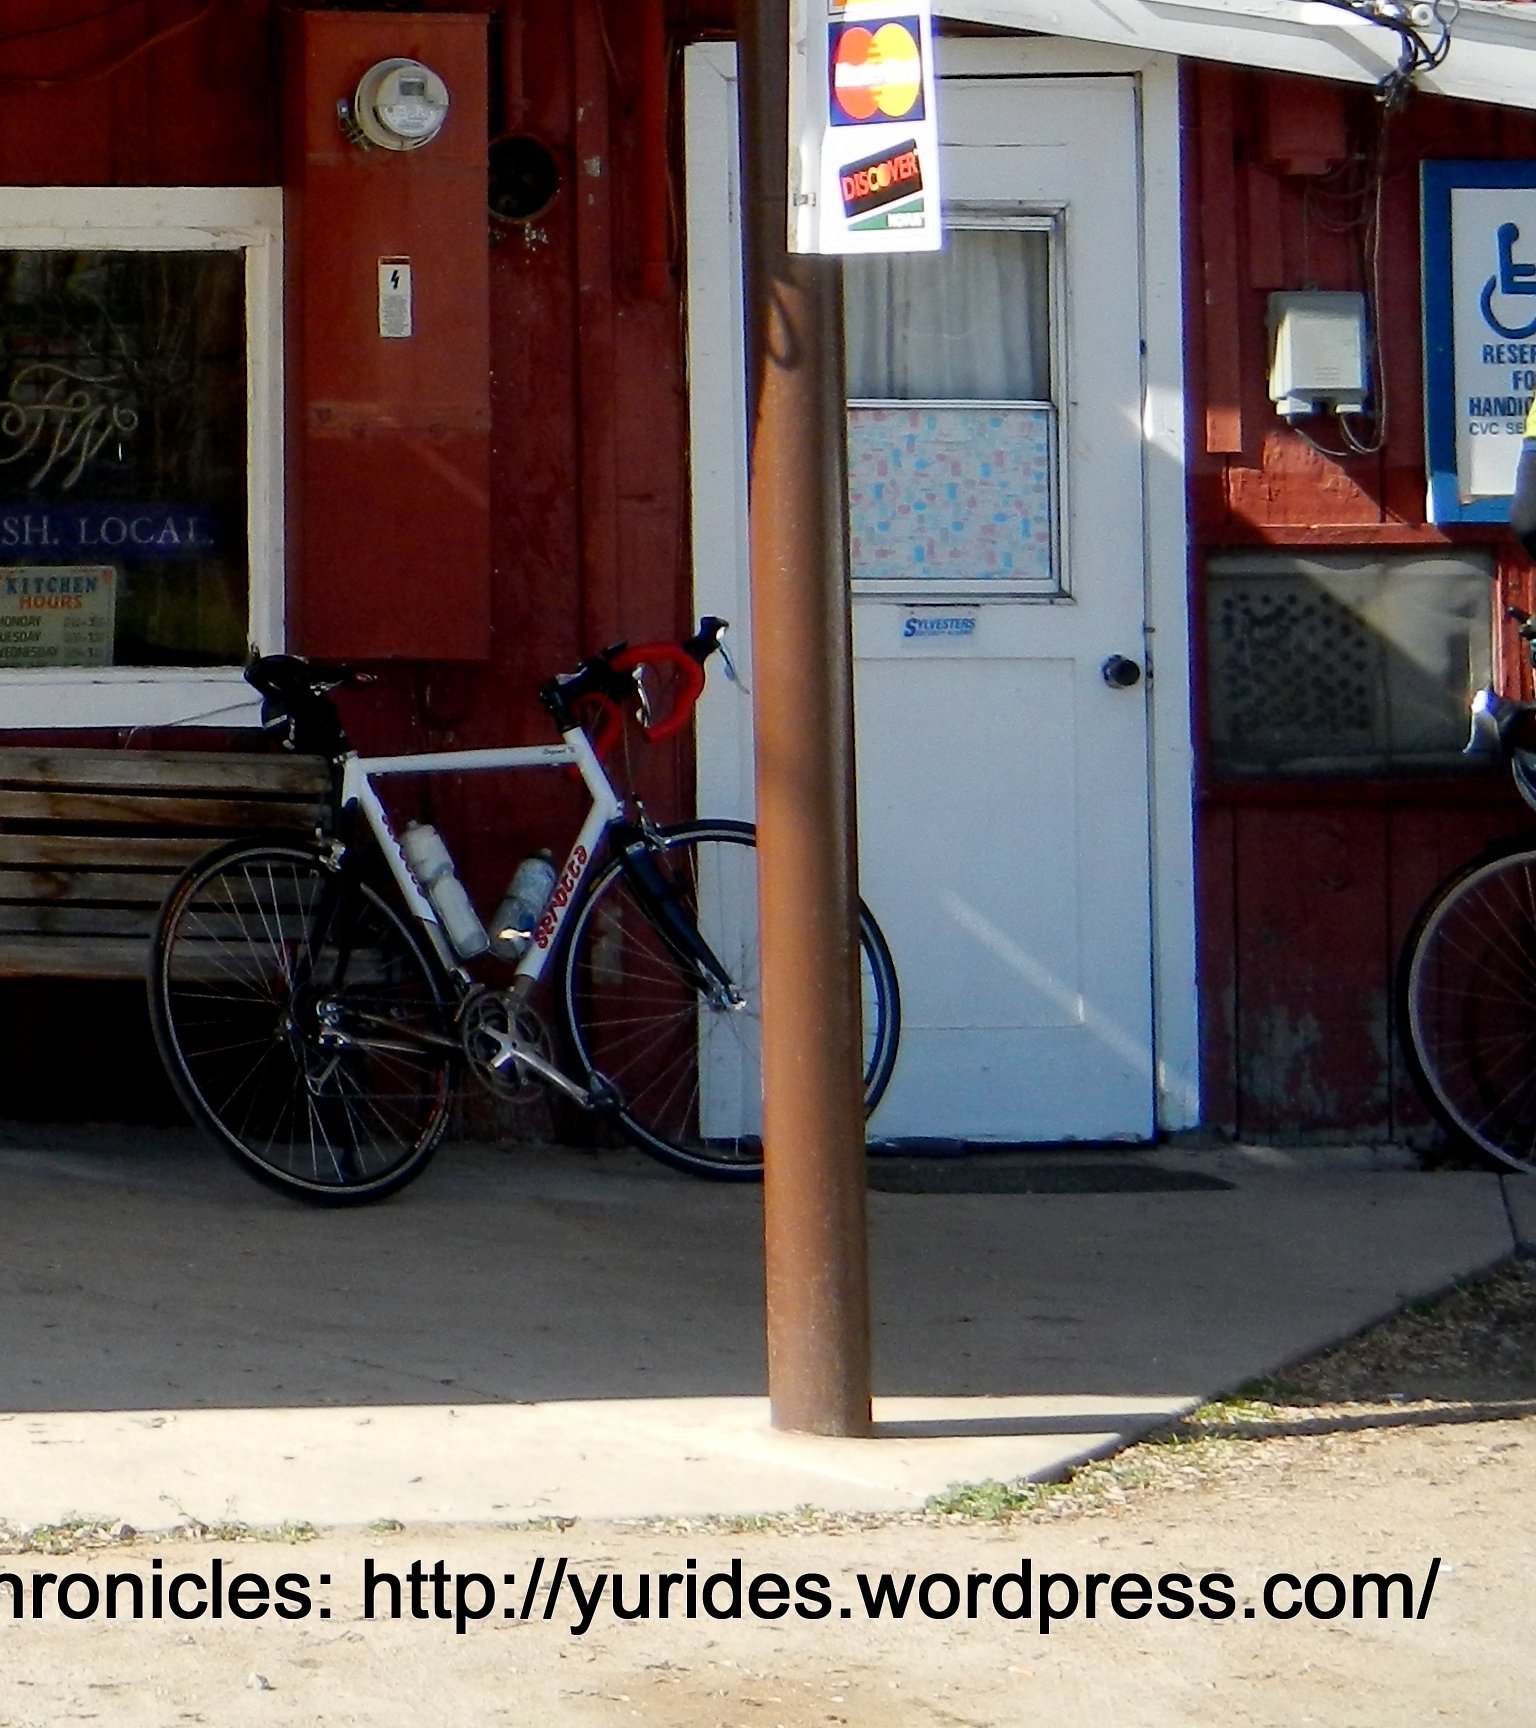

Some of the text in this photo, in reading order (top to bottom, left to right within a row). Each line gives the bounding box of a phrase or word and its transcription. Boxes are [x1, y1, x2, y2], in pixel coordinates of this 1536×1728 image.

[840, 151, 919, 202] DISCOVER
[1469, 421, 1500, 436] CVC
[5, 575, 98, 595] KITCHEN
[17, 595, 83, 610] HOURS
